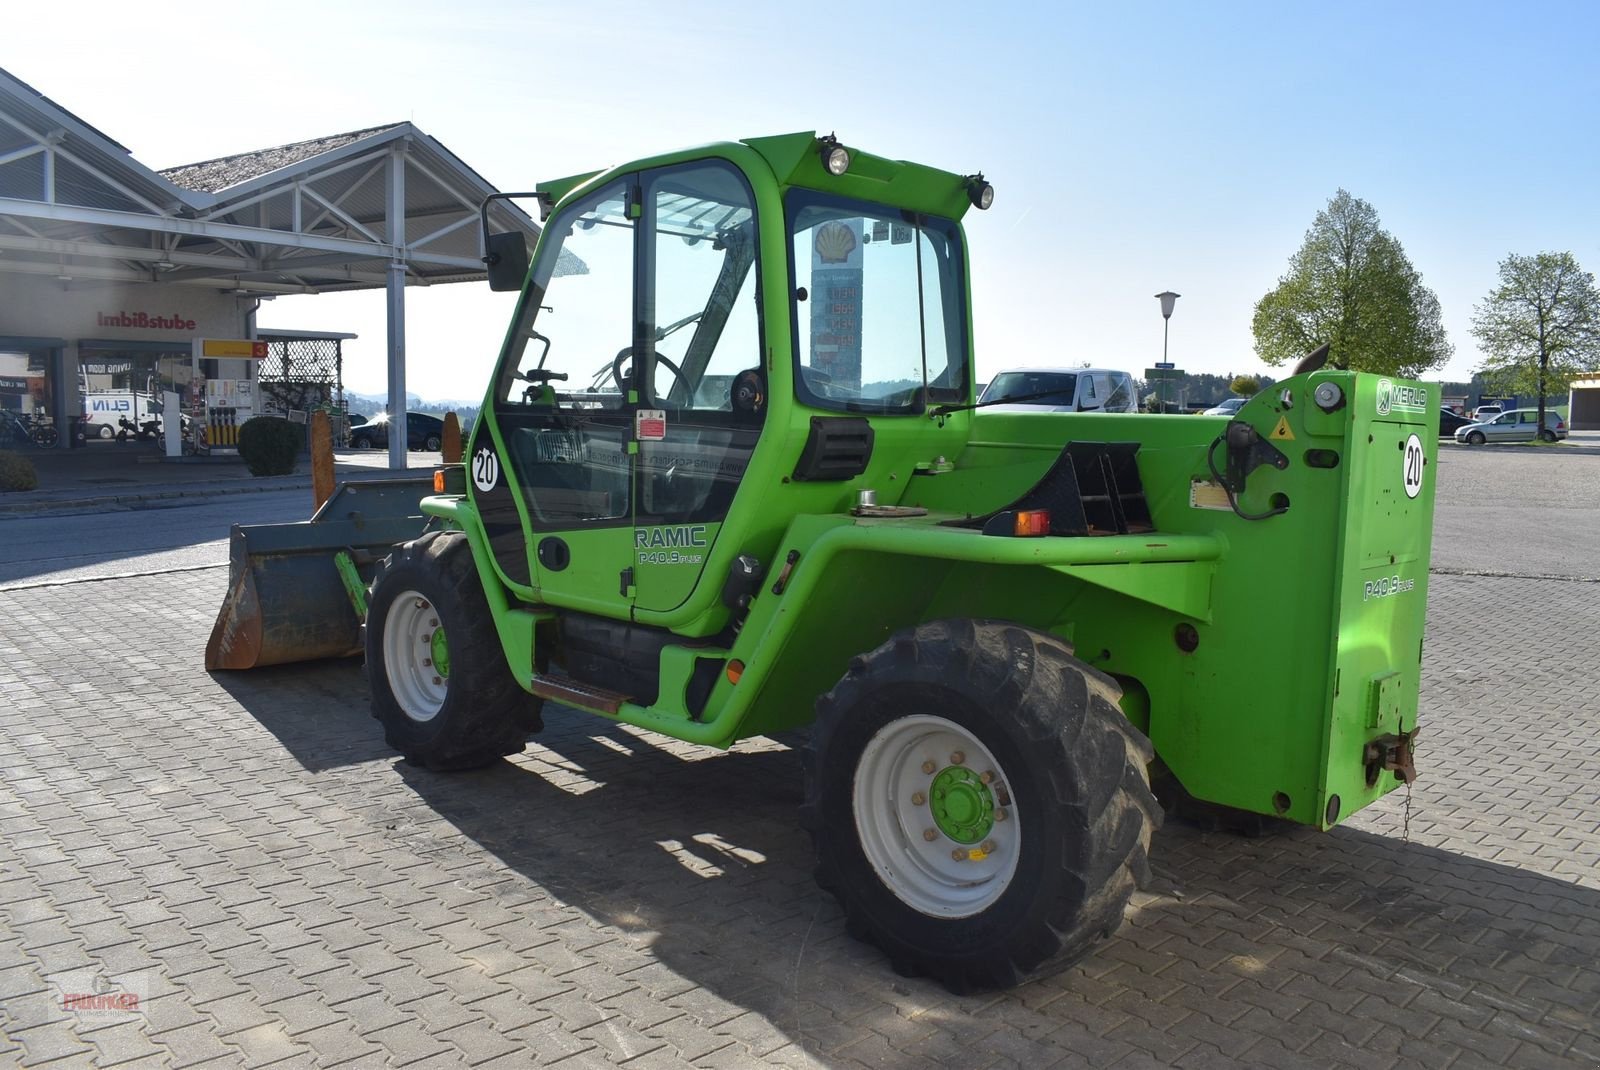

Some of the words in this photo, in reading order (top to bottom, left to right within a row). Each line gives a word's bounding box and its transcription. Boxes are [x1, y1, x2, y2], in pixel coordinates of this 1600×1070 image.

[97, 311, 196, 330] Imbißstube
[256, 344, 265, 356] 3
[1391, 385, 1427, 407] MERLO
[477, 453, 494, 485] 20
[1406, 445, 1420, 487] 20
[634, 525, 706, 548] RAMIC
